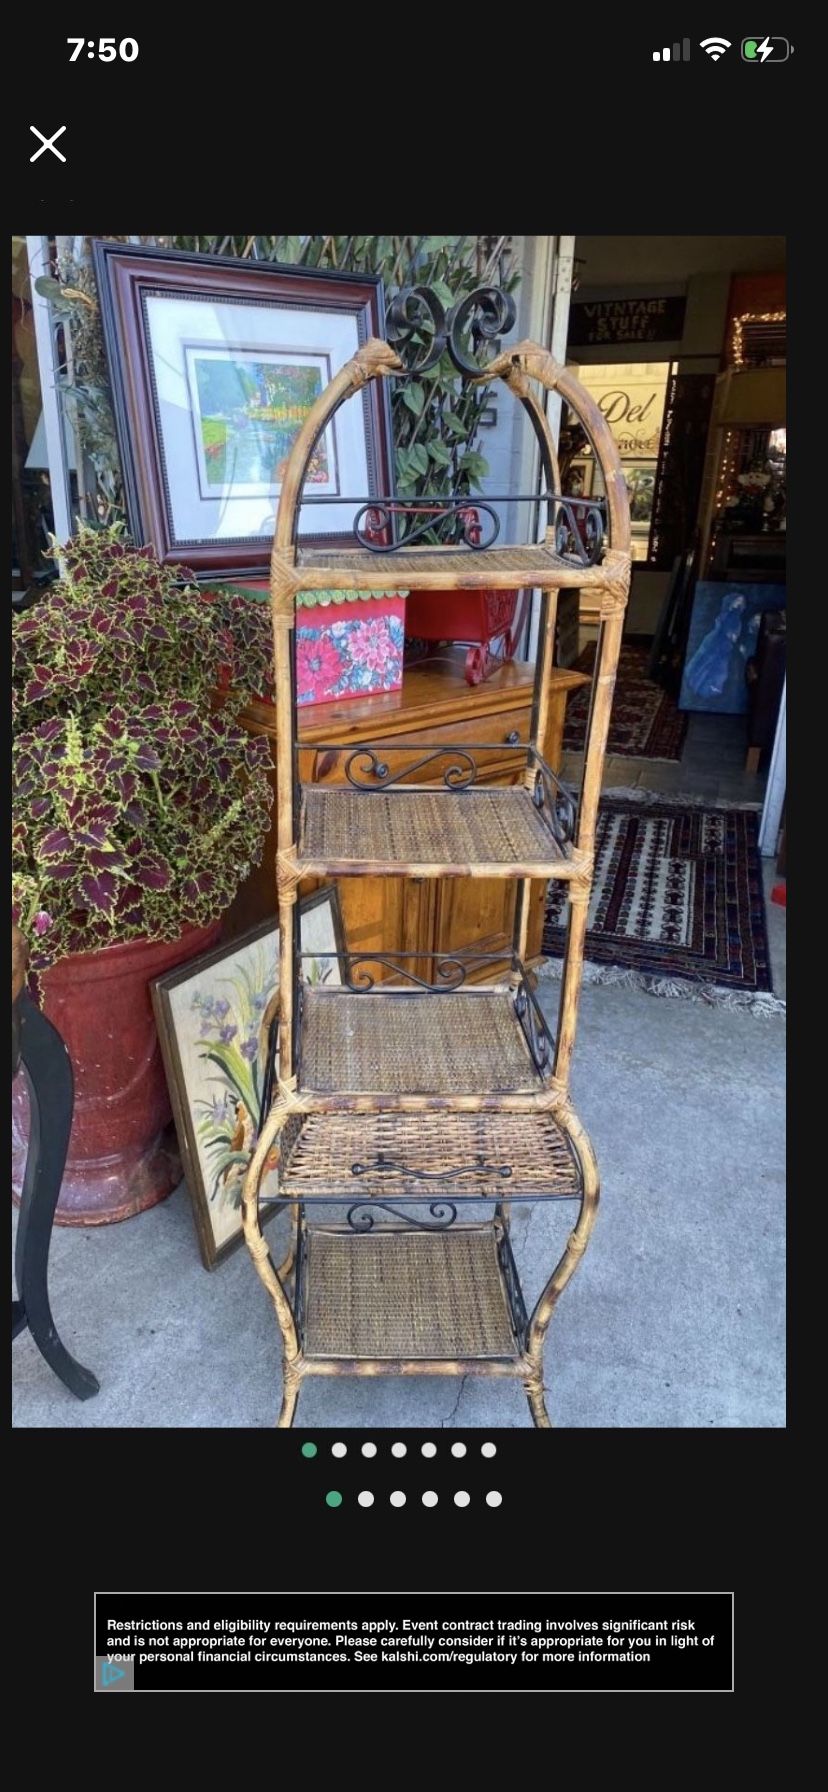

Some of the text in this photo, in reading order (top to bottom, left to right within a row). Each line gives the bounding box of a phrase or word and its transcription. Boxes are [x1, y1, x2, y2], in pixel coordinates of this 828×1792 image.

[584, 299, 667, 317] VITNTAGE
[597, 315, 649, 331] STUFF
[588, 331, 611, 342] FOR
[597, 390, 657, 423] Del
